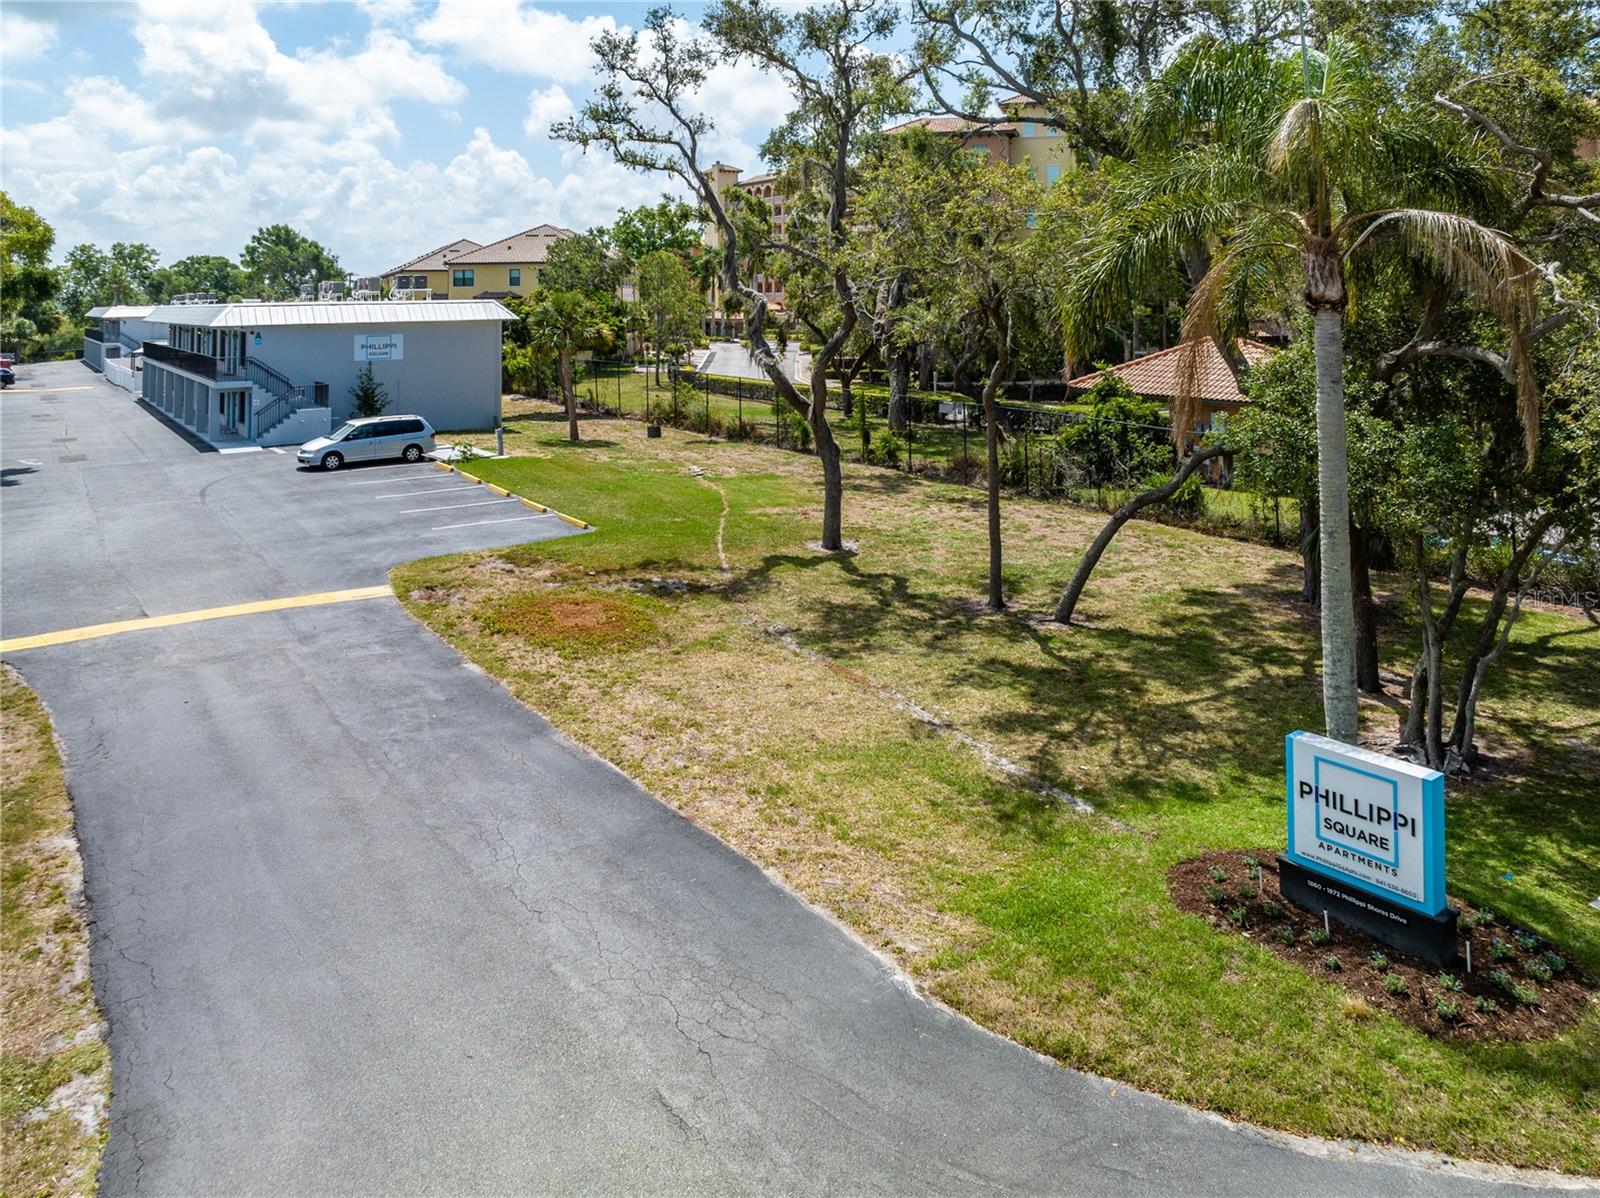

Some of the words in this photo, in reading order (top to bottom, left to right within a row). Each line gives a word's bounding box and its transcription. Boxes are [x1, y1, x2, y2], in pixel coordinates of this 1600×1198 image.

[1299, 780, 1416, 838] PHILLIPPI
[1323, 817, 1390, 851] SQUARE
[1318, 841, 1399, 877] APARTMENTS
[1307, 879, 1322, 890] 1860
[1326, 887, 1341, 898] 1872
[1341, 893, 1366, 908] Phillippi
[1367, 903, 1389, 918] Shores
[1389, 912, 1408, 925] Drive
